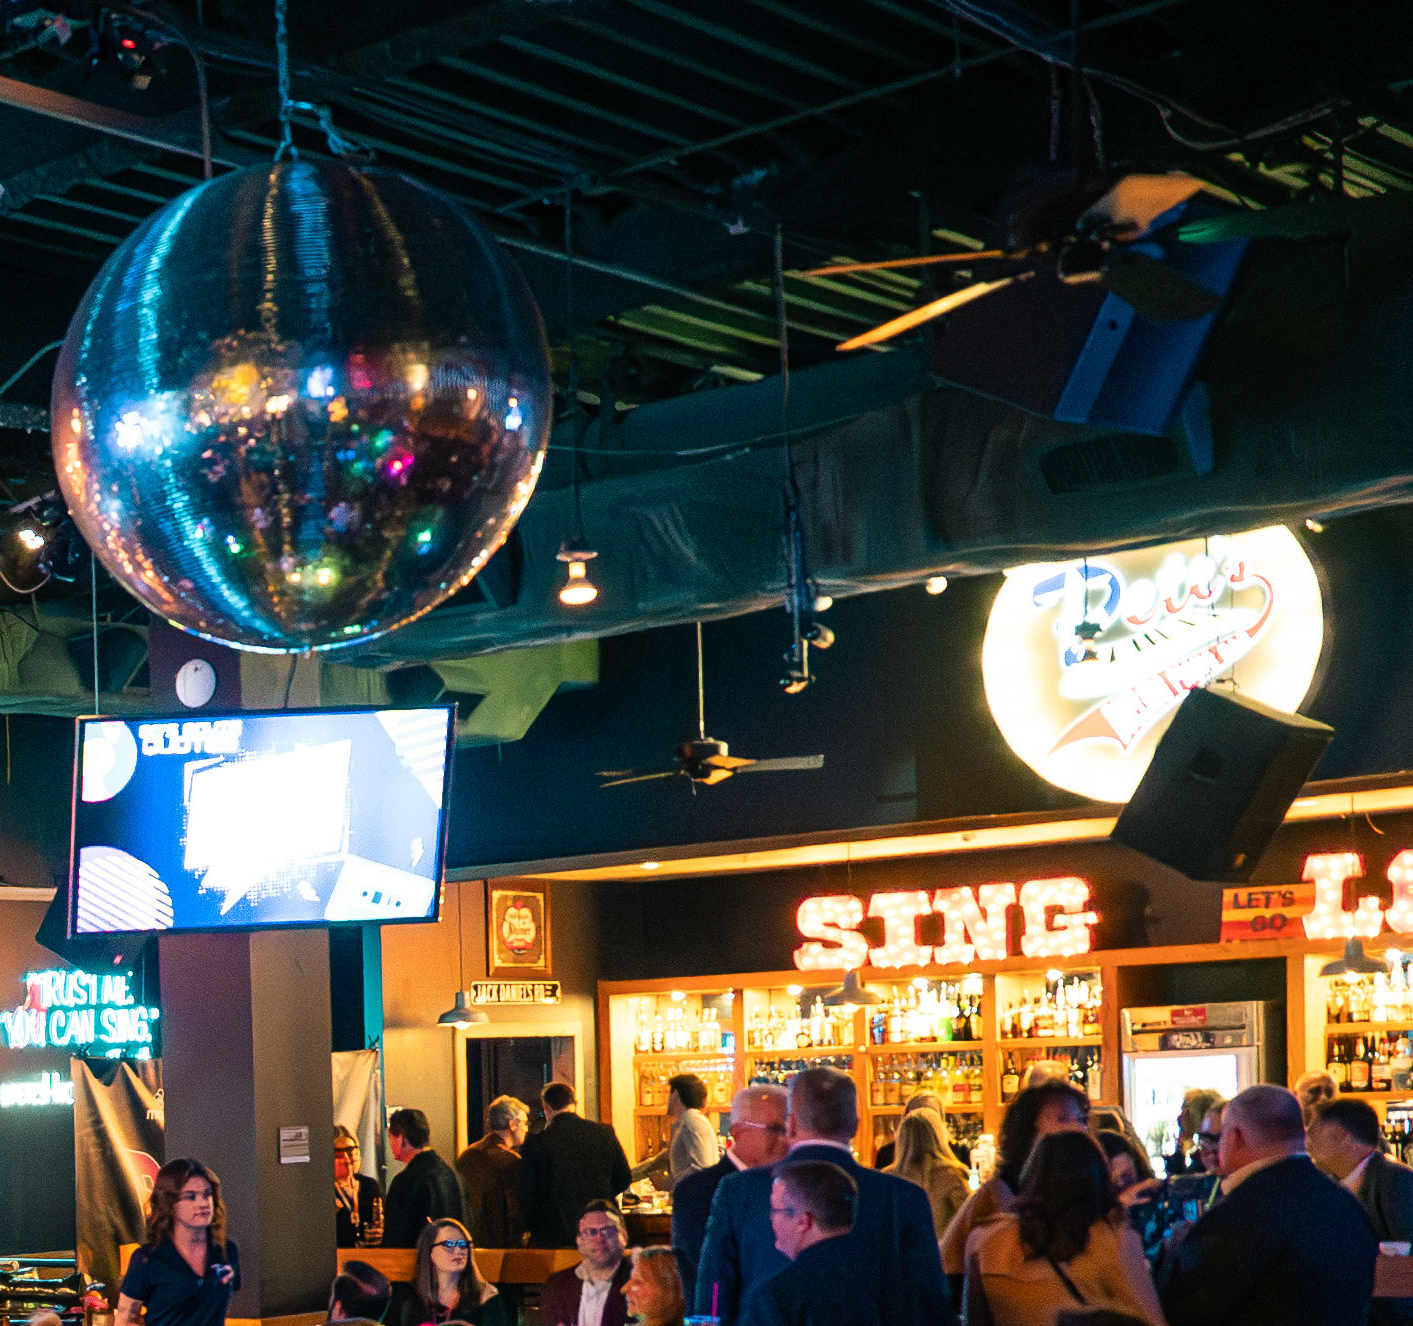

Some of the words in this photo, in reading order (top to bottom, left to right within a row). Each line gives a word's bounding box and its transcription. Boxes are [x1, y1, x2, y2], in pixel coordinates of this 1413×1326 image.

[1233, 890, 1295, 911] LET'S
[793, 877, 1100, 971] SING
[1249, 914, 1288, 932] GO
[476, 984, 499, 1004] JACK
[50, 1009, 96, 1045] CAN
